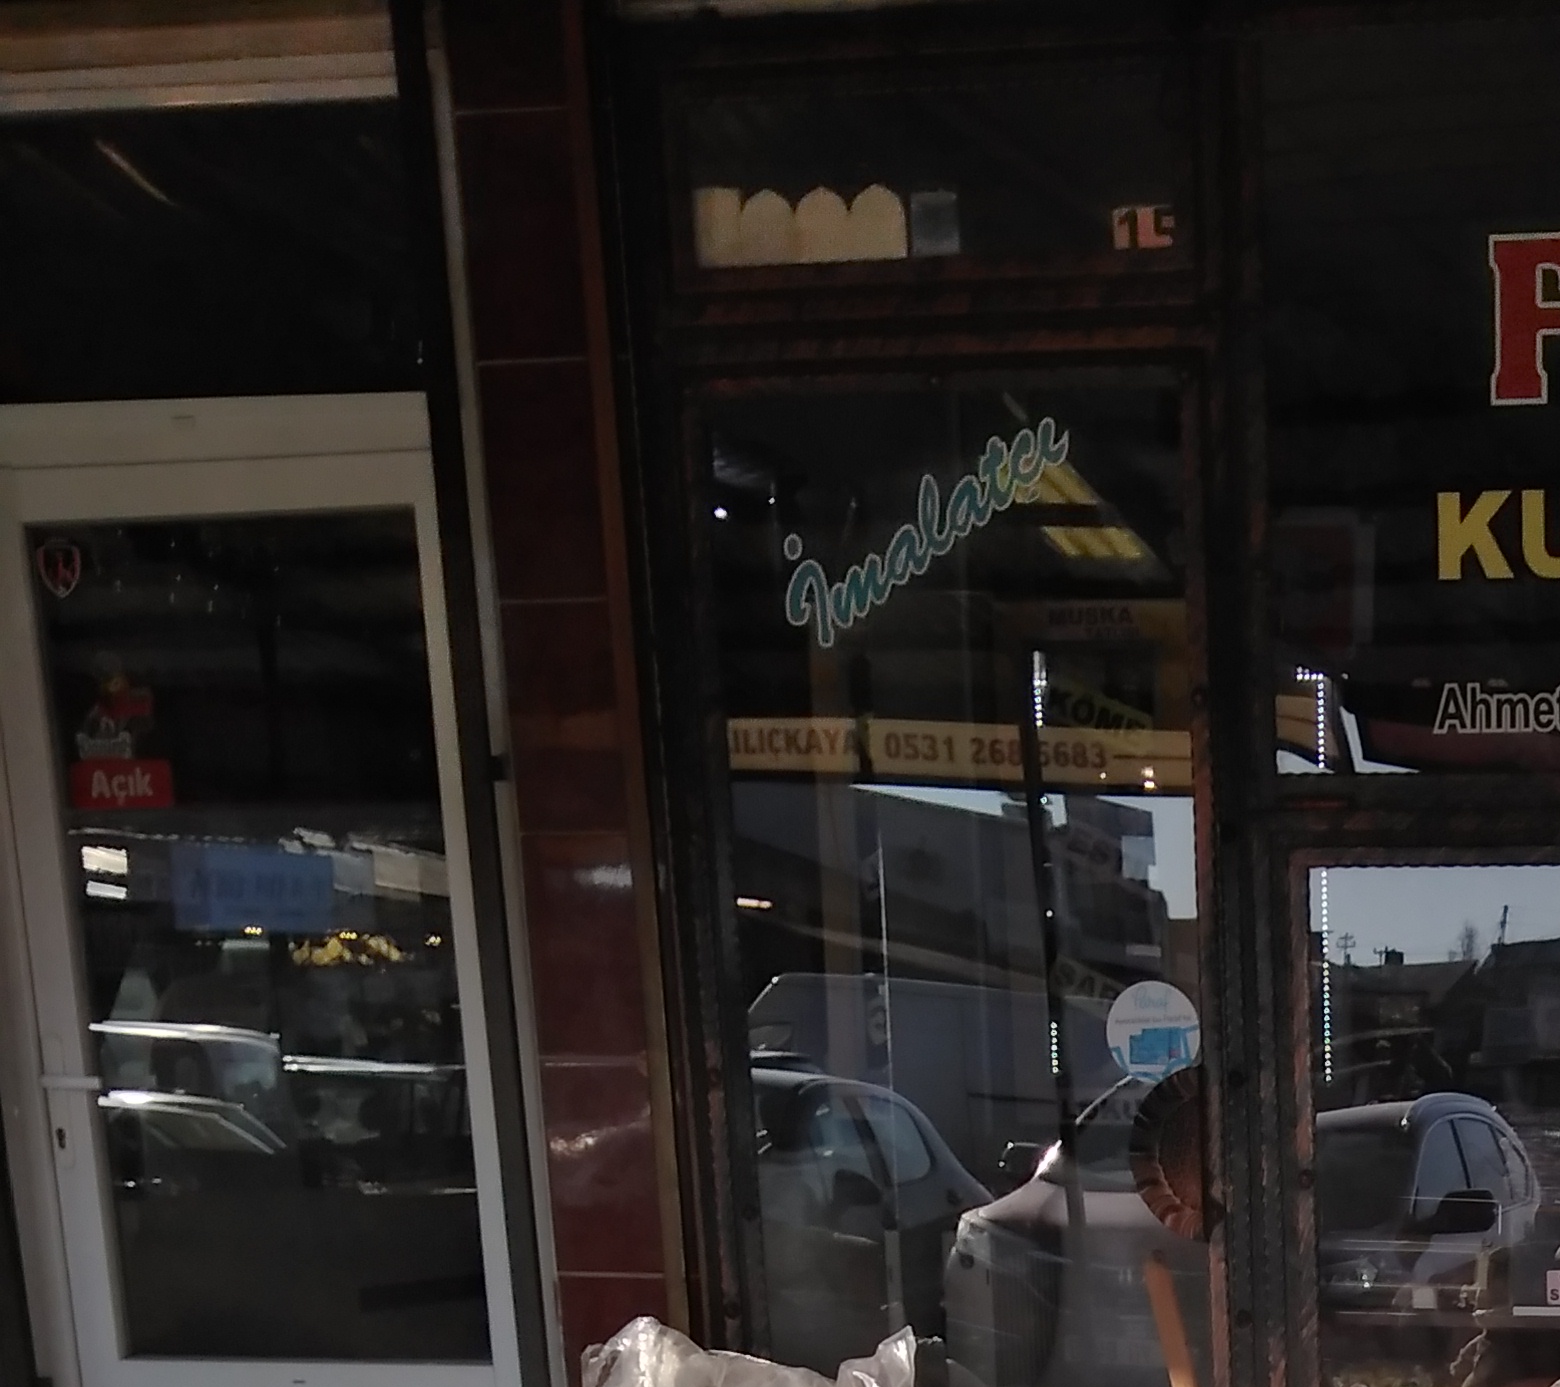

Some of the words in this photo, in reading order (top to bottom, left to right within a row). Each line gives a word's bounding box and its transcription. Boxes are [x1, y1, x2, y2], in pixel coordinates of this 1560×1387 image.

[785, 416, 1069, 648] İmalatçı
[884, 732, 955, 763] 0531
[91, 766, 153, 807] Açık
